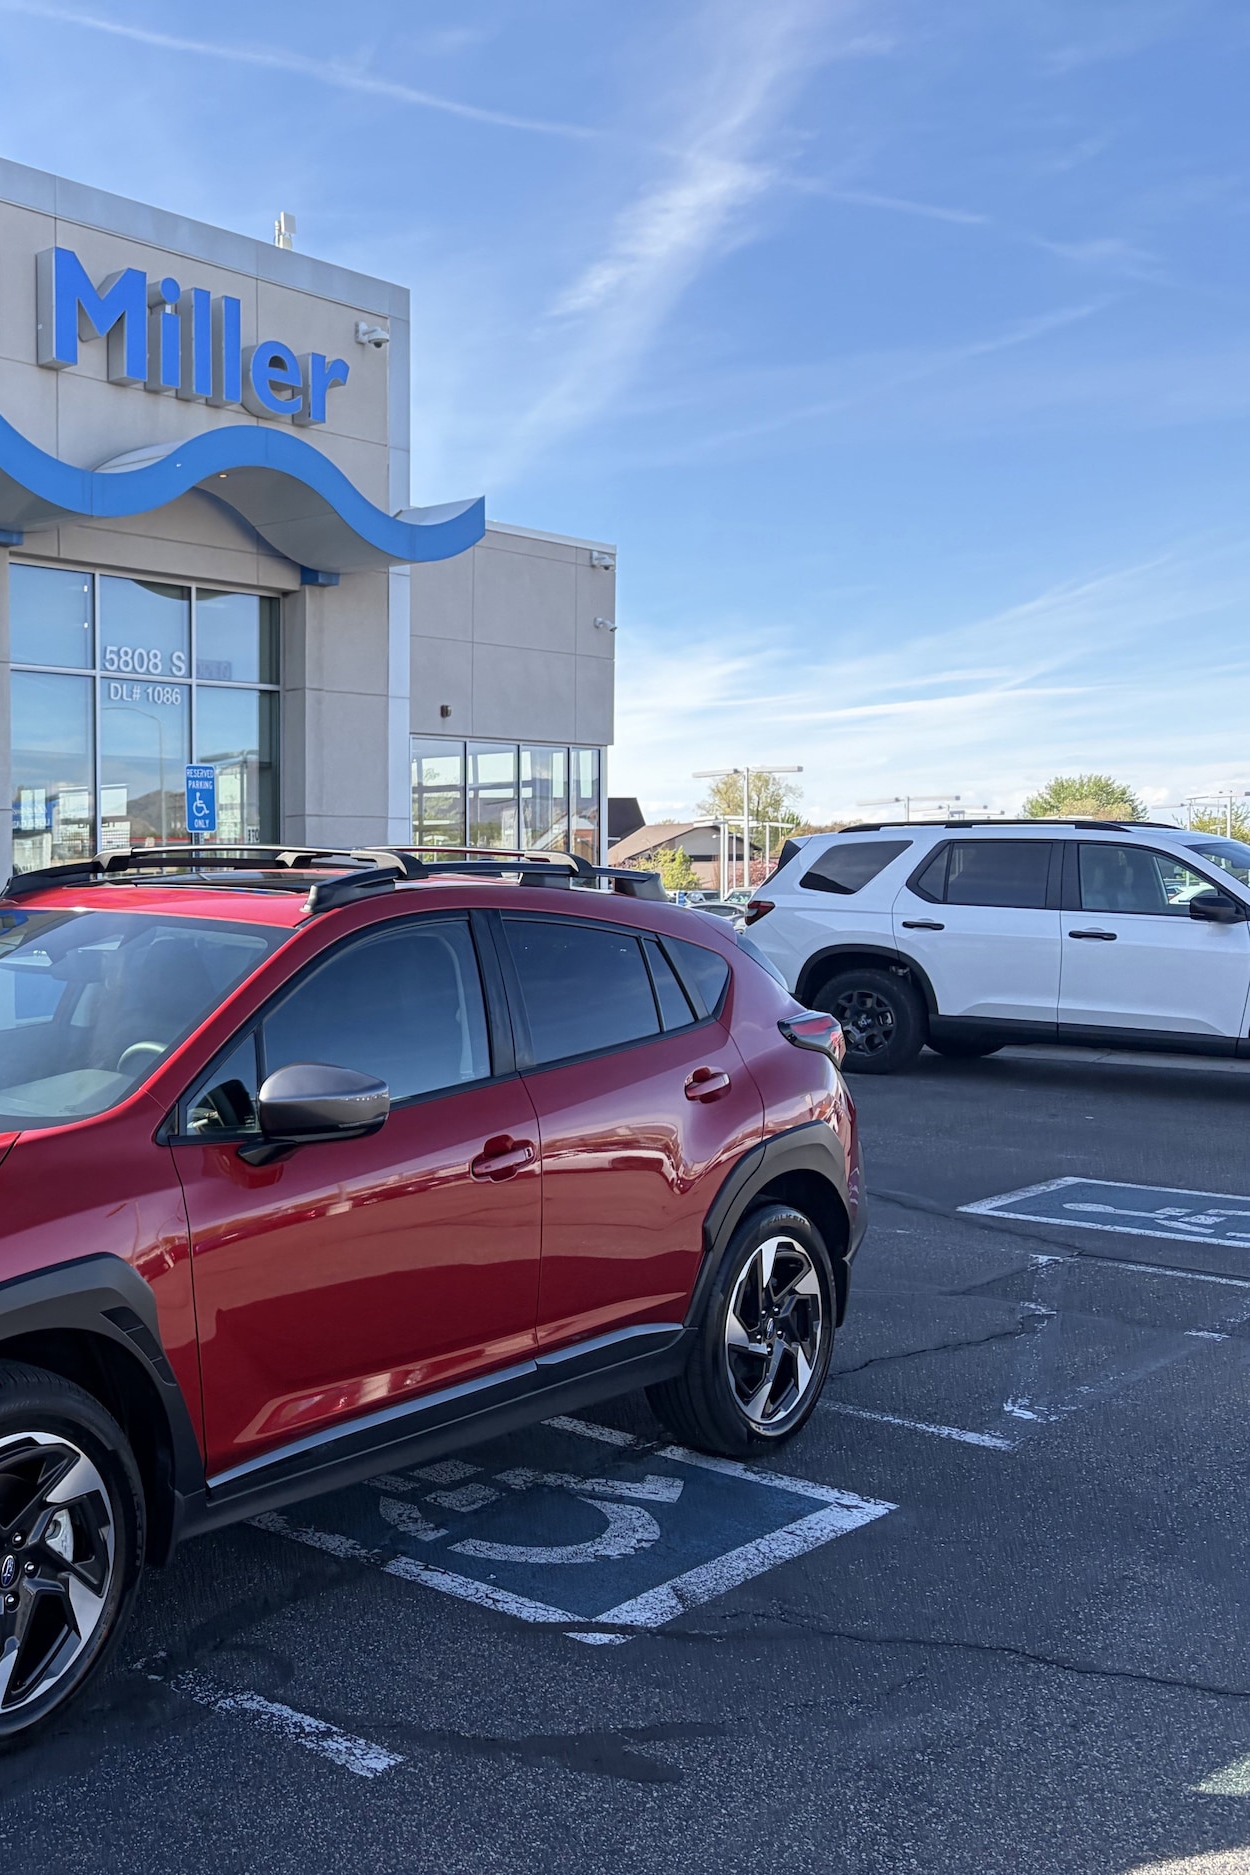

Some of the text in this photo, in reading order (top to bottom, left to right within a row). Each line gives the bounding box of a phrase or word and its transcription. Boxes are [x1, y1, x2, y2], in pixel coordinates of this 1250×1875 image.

[36, 245, 350, 426] Miller
[104, 646, 162, 675] 5808
[171, 651, 186, 677] S
[110, 682, 181, 705] DL# 1086
[186, 768, 214, 779] RESERVED
[188, 780, 213, 790] PARKING
[194, 818, 210, 829] ONLY
